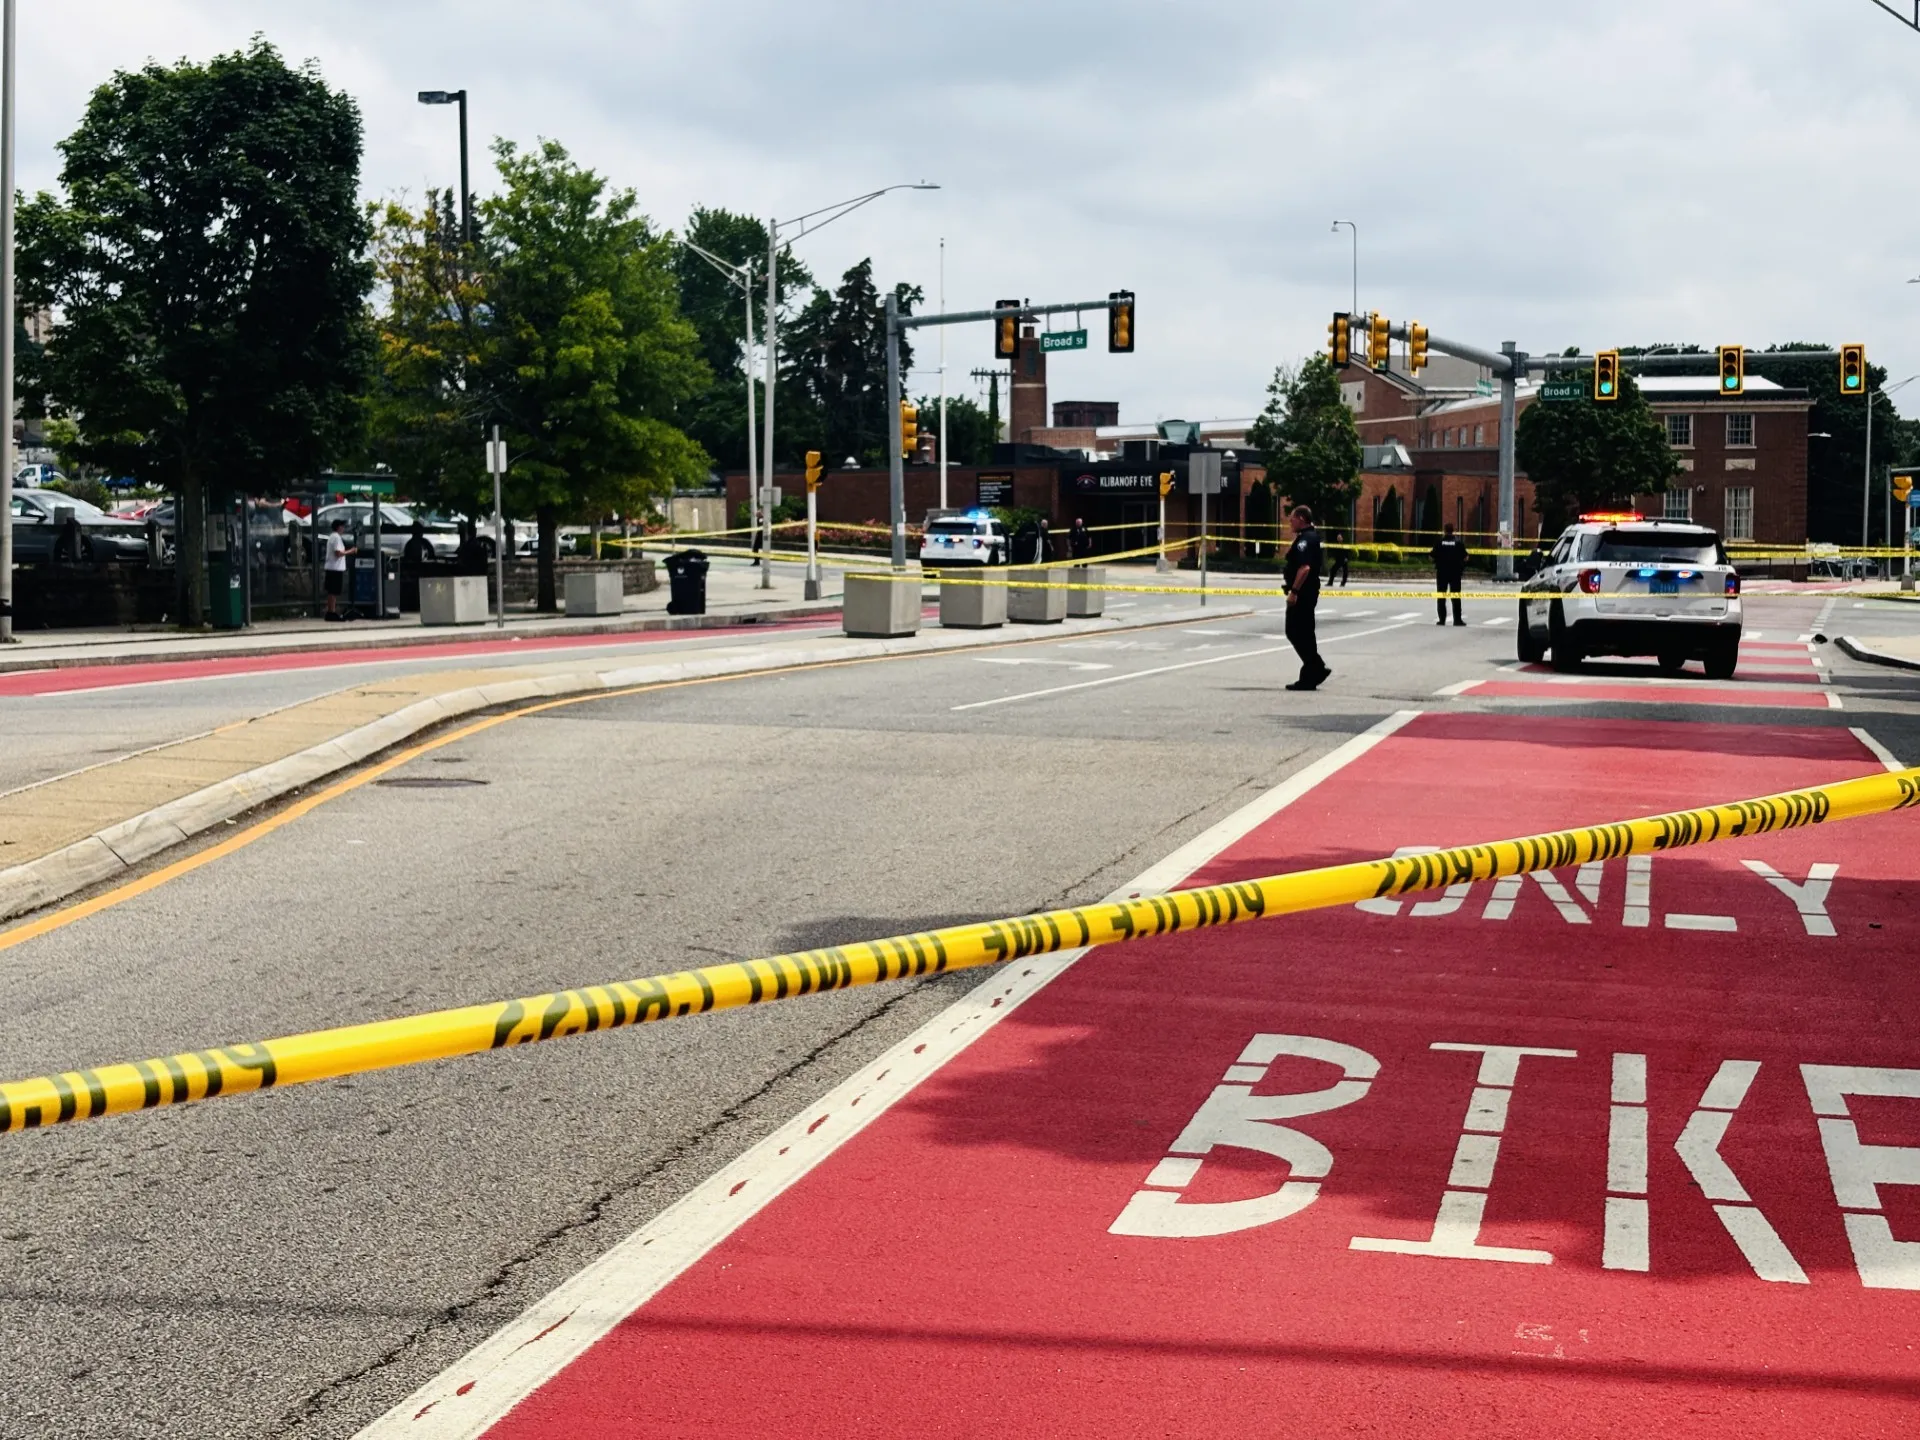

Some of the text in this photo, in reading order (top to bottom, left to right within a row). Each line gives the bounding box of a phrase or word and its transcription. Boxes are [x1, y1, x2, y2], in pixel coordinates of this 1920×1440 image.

[1043, 336, 1084, 348] Broad St
[1543, 387, 1570, 396] Broad
[1099, 476, 1153, 487] KLIBANOFF EYE
[1106, 1032, 1920, 1290] BIKE
